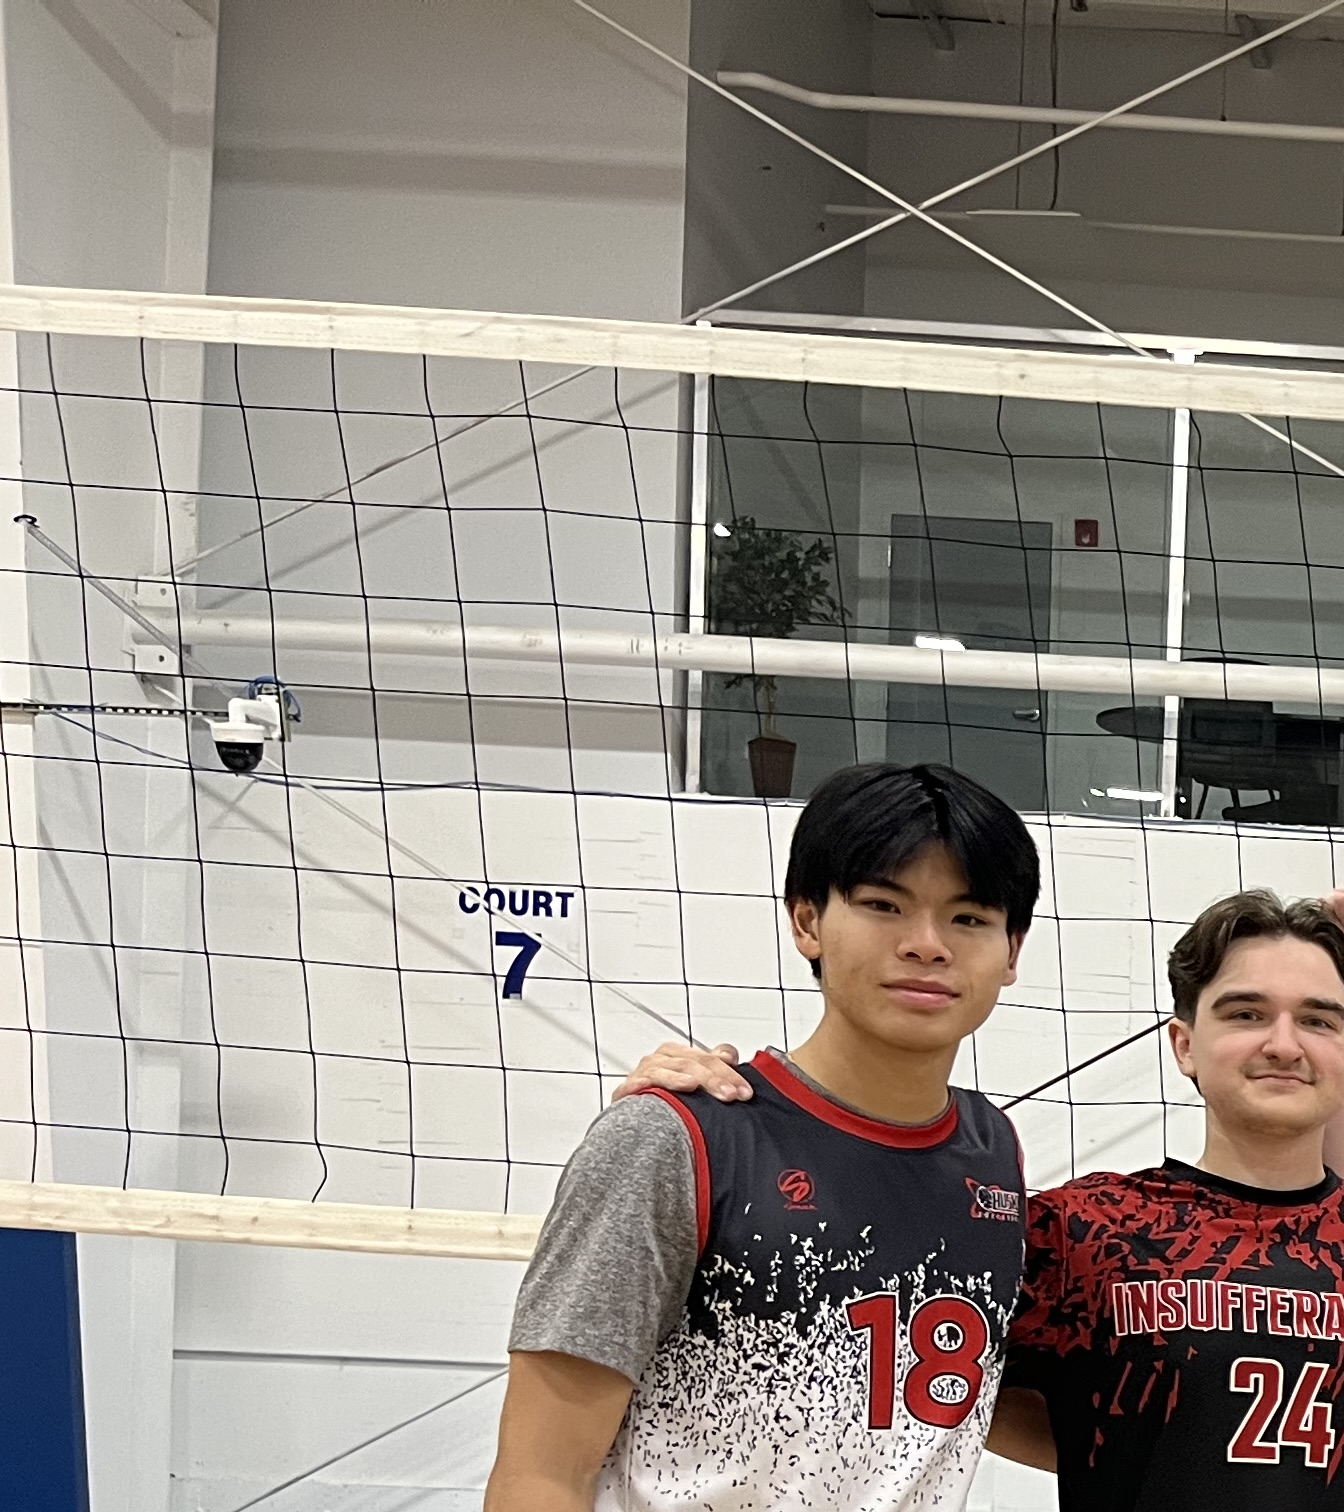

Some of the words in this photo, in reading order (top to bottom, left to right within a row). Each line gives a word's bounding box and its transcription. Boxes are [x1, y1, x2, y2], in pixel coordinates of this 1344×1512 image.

[458, 886, 575, 918] COURT
[495, 930, 542, 1000] 7
[845, 1290, 991, 1430] 18
[1226, 1356, 1335, 1468] 24
